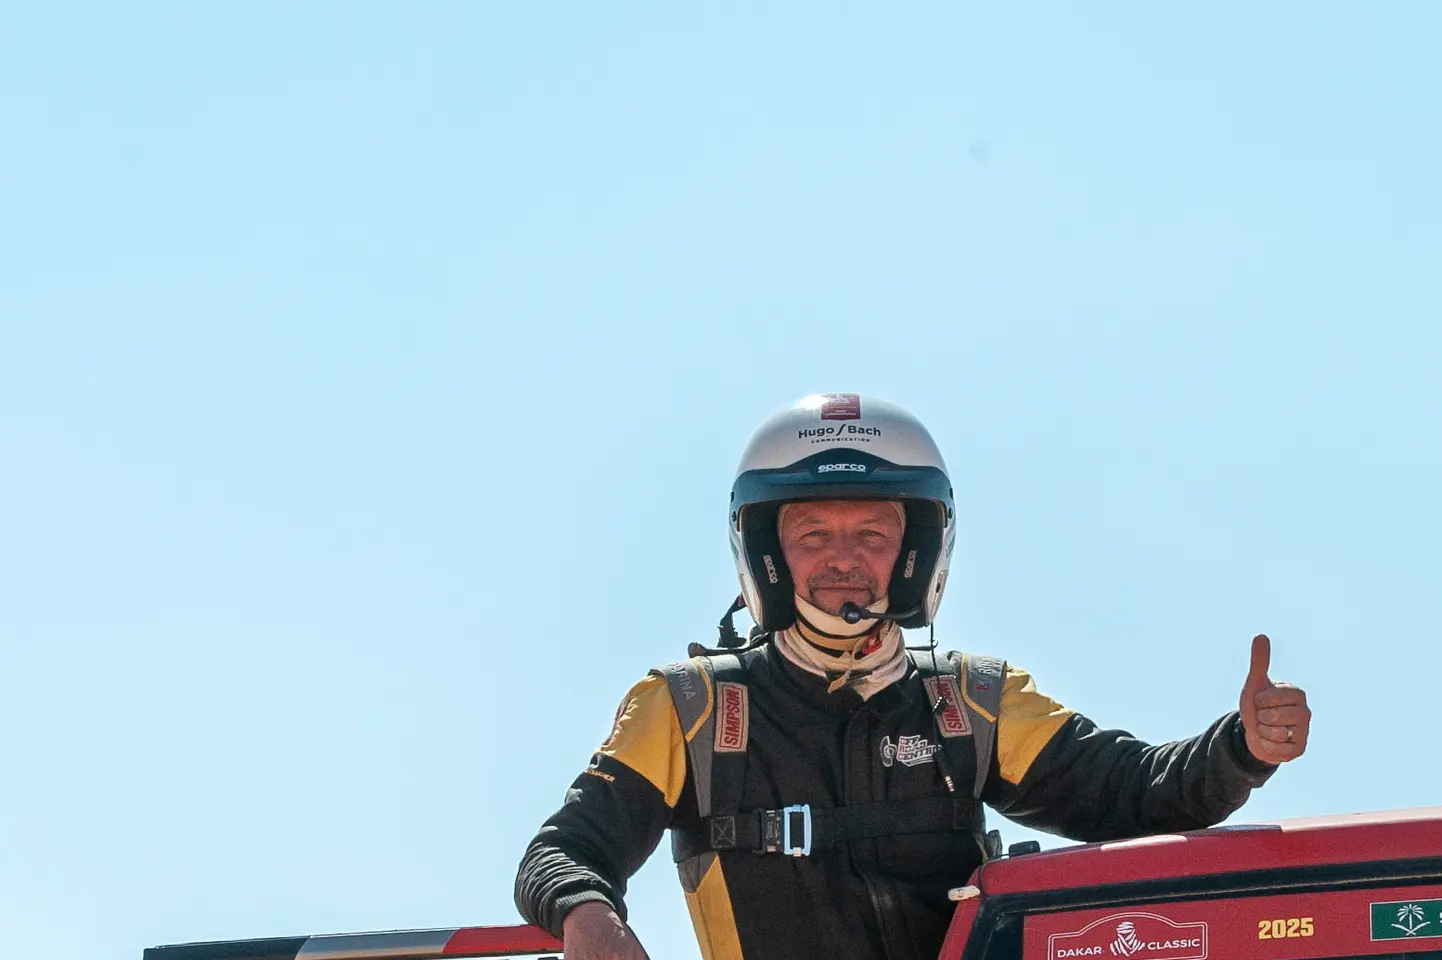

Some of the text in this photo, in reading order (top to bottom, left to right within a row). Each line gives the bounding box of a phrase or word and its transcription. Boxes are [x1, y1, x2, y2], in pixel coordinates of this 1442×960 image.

[798, 424, 882, 440] Hugo Bach
[724, 689, 740, 746] SIMPSON
[1258, 918, 1314, 940] 2025
[1057, 938, 1201, 958] DAKAR CLASSIC
